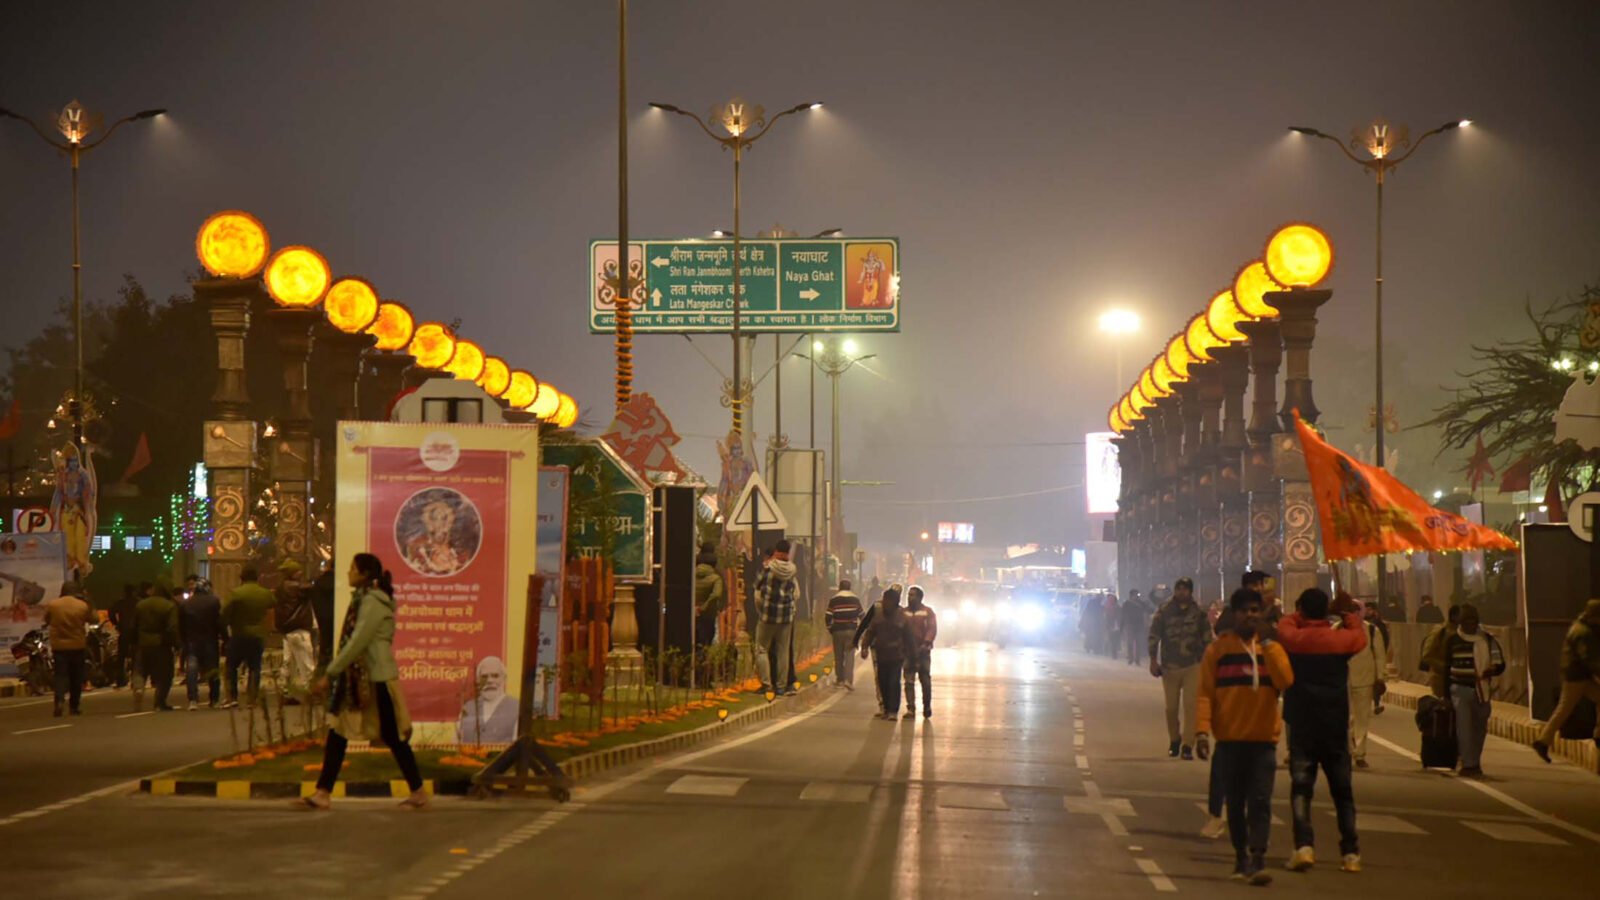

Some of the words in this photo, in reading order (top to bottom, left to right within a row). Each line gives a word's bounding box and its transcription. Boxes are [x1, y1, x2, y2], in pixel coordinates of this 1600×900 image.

[670, 246, 692, 262] श्रीराम
[696, 246, 728, 266] जन्मभूमि
[750, 246, 764, 262] क्षेत्र
[791, 251, 829, 264] नयाघाट
[670, 266, 682, 277] Shri
[683, 266, 696, 277] Ram
[785, 270, 808, 284] Naya
[811, 270, 834, 282] Ghat
[670, 284, 687, 296] लता
[690, 281, 724, 296] मंगेशकर
[669, 298, 684, 310] Lata
[725, 298, 750, 310] Chwk
[666, 316, 684, 324] आप
[688, 314, 705, 324] सभी
[753, 316, 766, 324] का
[770, 316, 796, 324] स्वागत
[865, 313, 887, 324] विभाग
[398, 660, 468, 682] अभिनंदन
